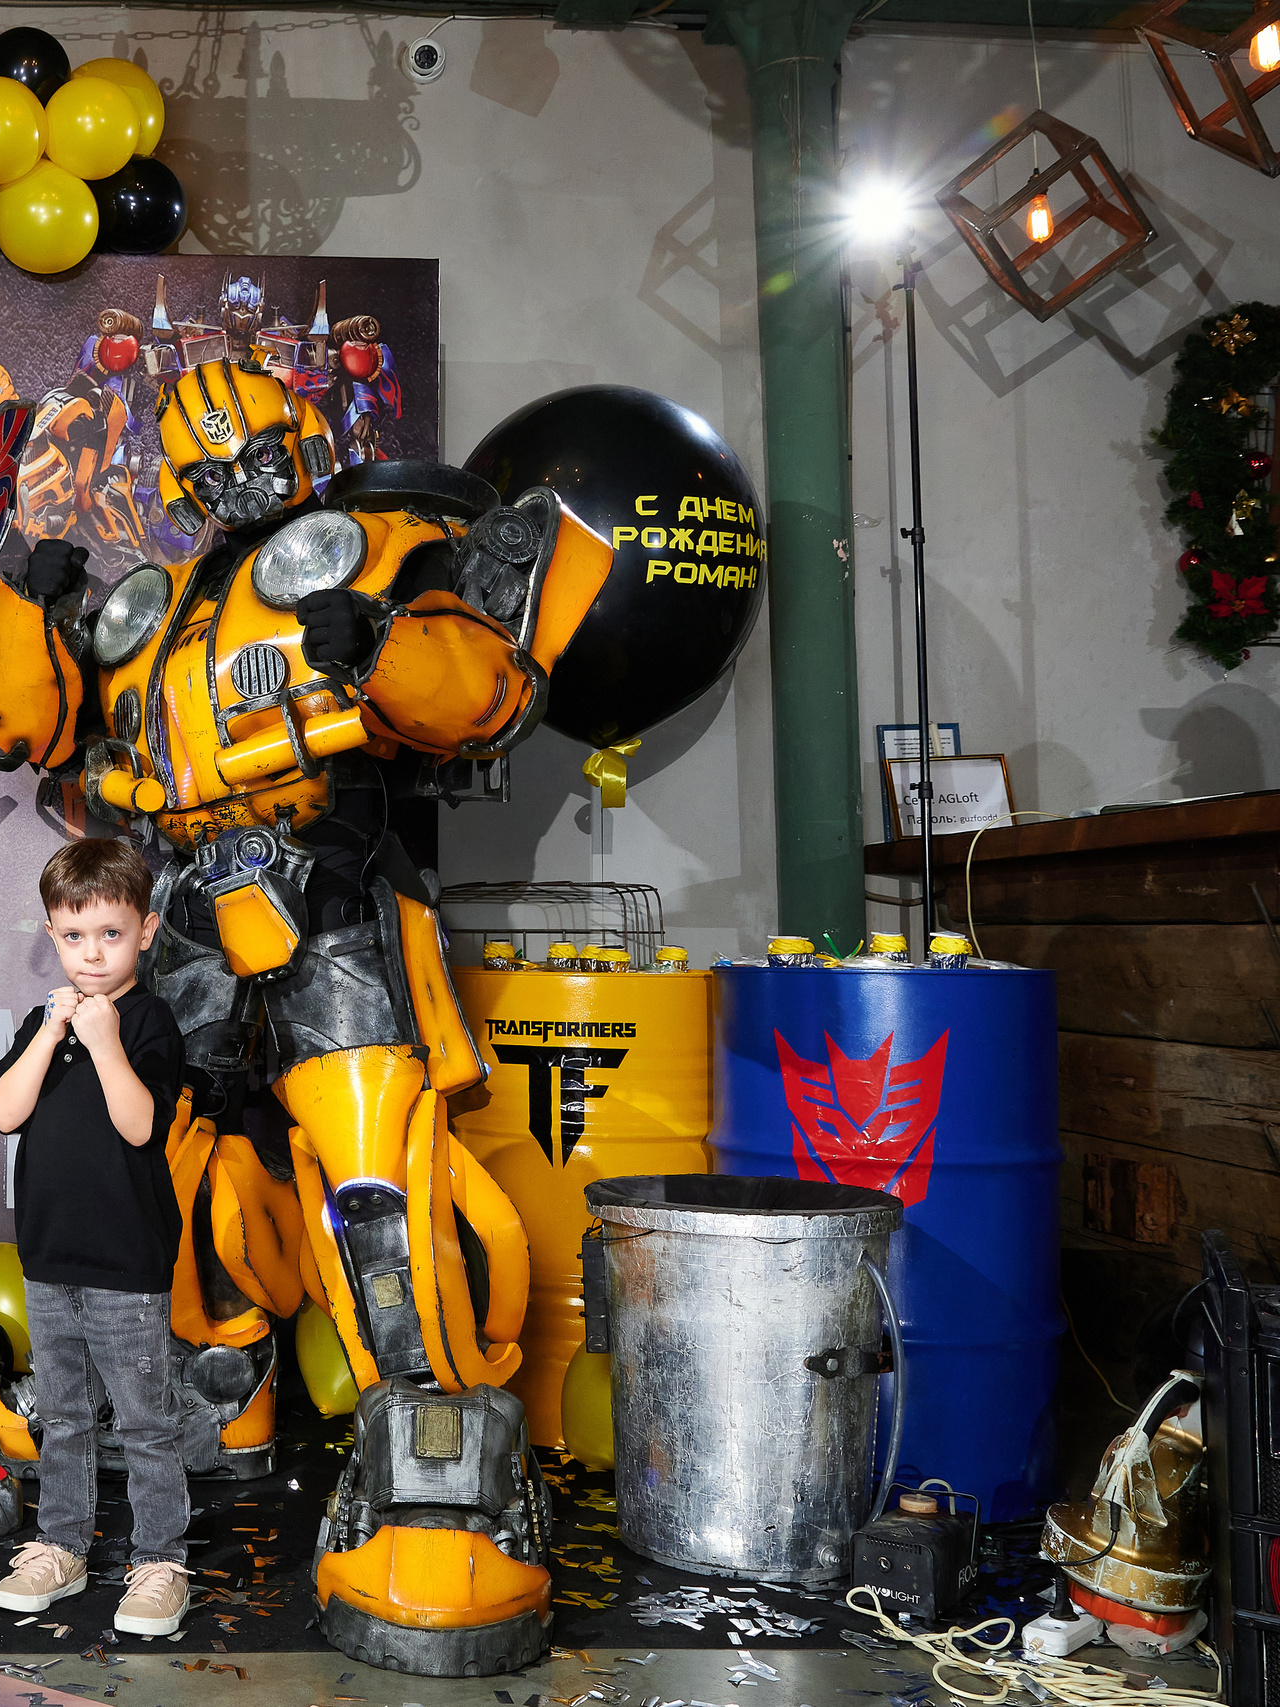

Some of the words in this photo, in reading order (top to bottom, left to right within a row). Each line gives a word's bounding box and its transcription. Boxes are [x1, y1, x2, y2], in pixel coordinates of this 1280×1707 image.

[634, 495, 659, 516] С
[678, 496, 756, 531] ДНЕМ
[645, 560, 758, 590] РОМАН!
[938, 792, 979, 804] AGLoft
[907, 814, 957, 825] Паоль:
[484, 1018, 637, 1044] TRANSFORMERS
